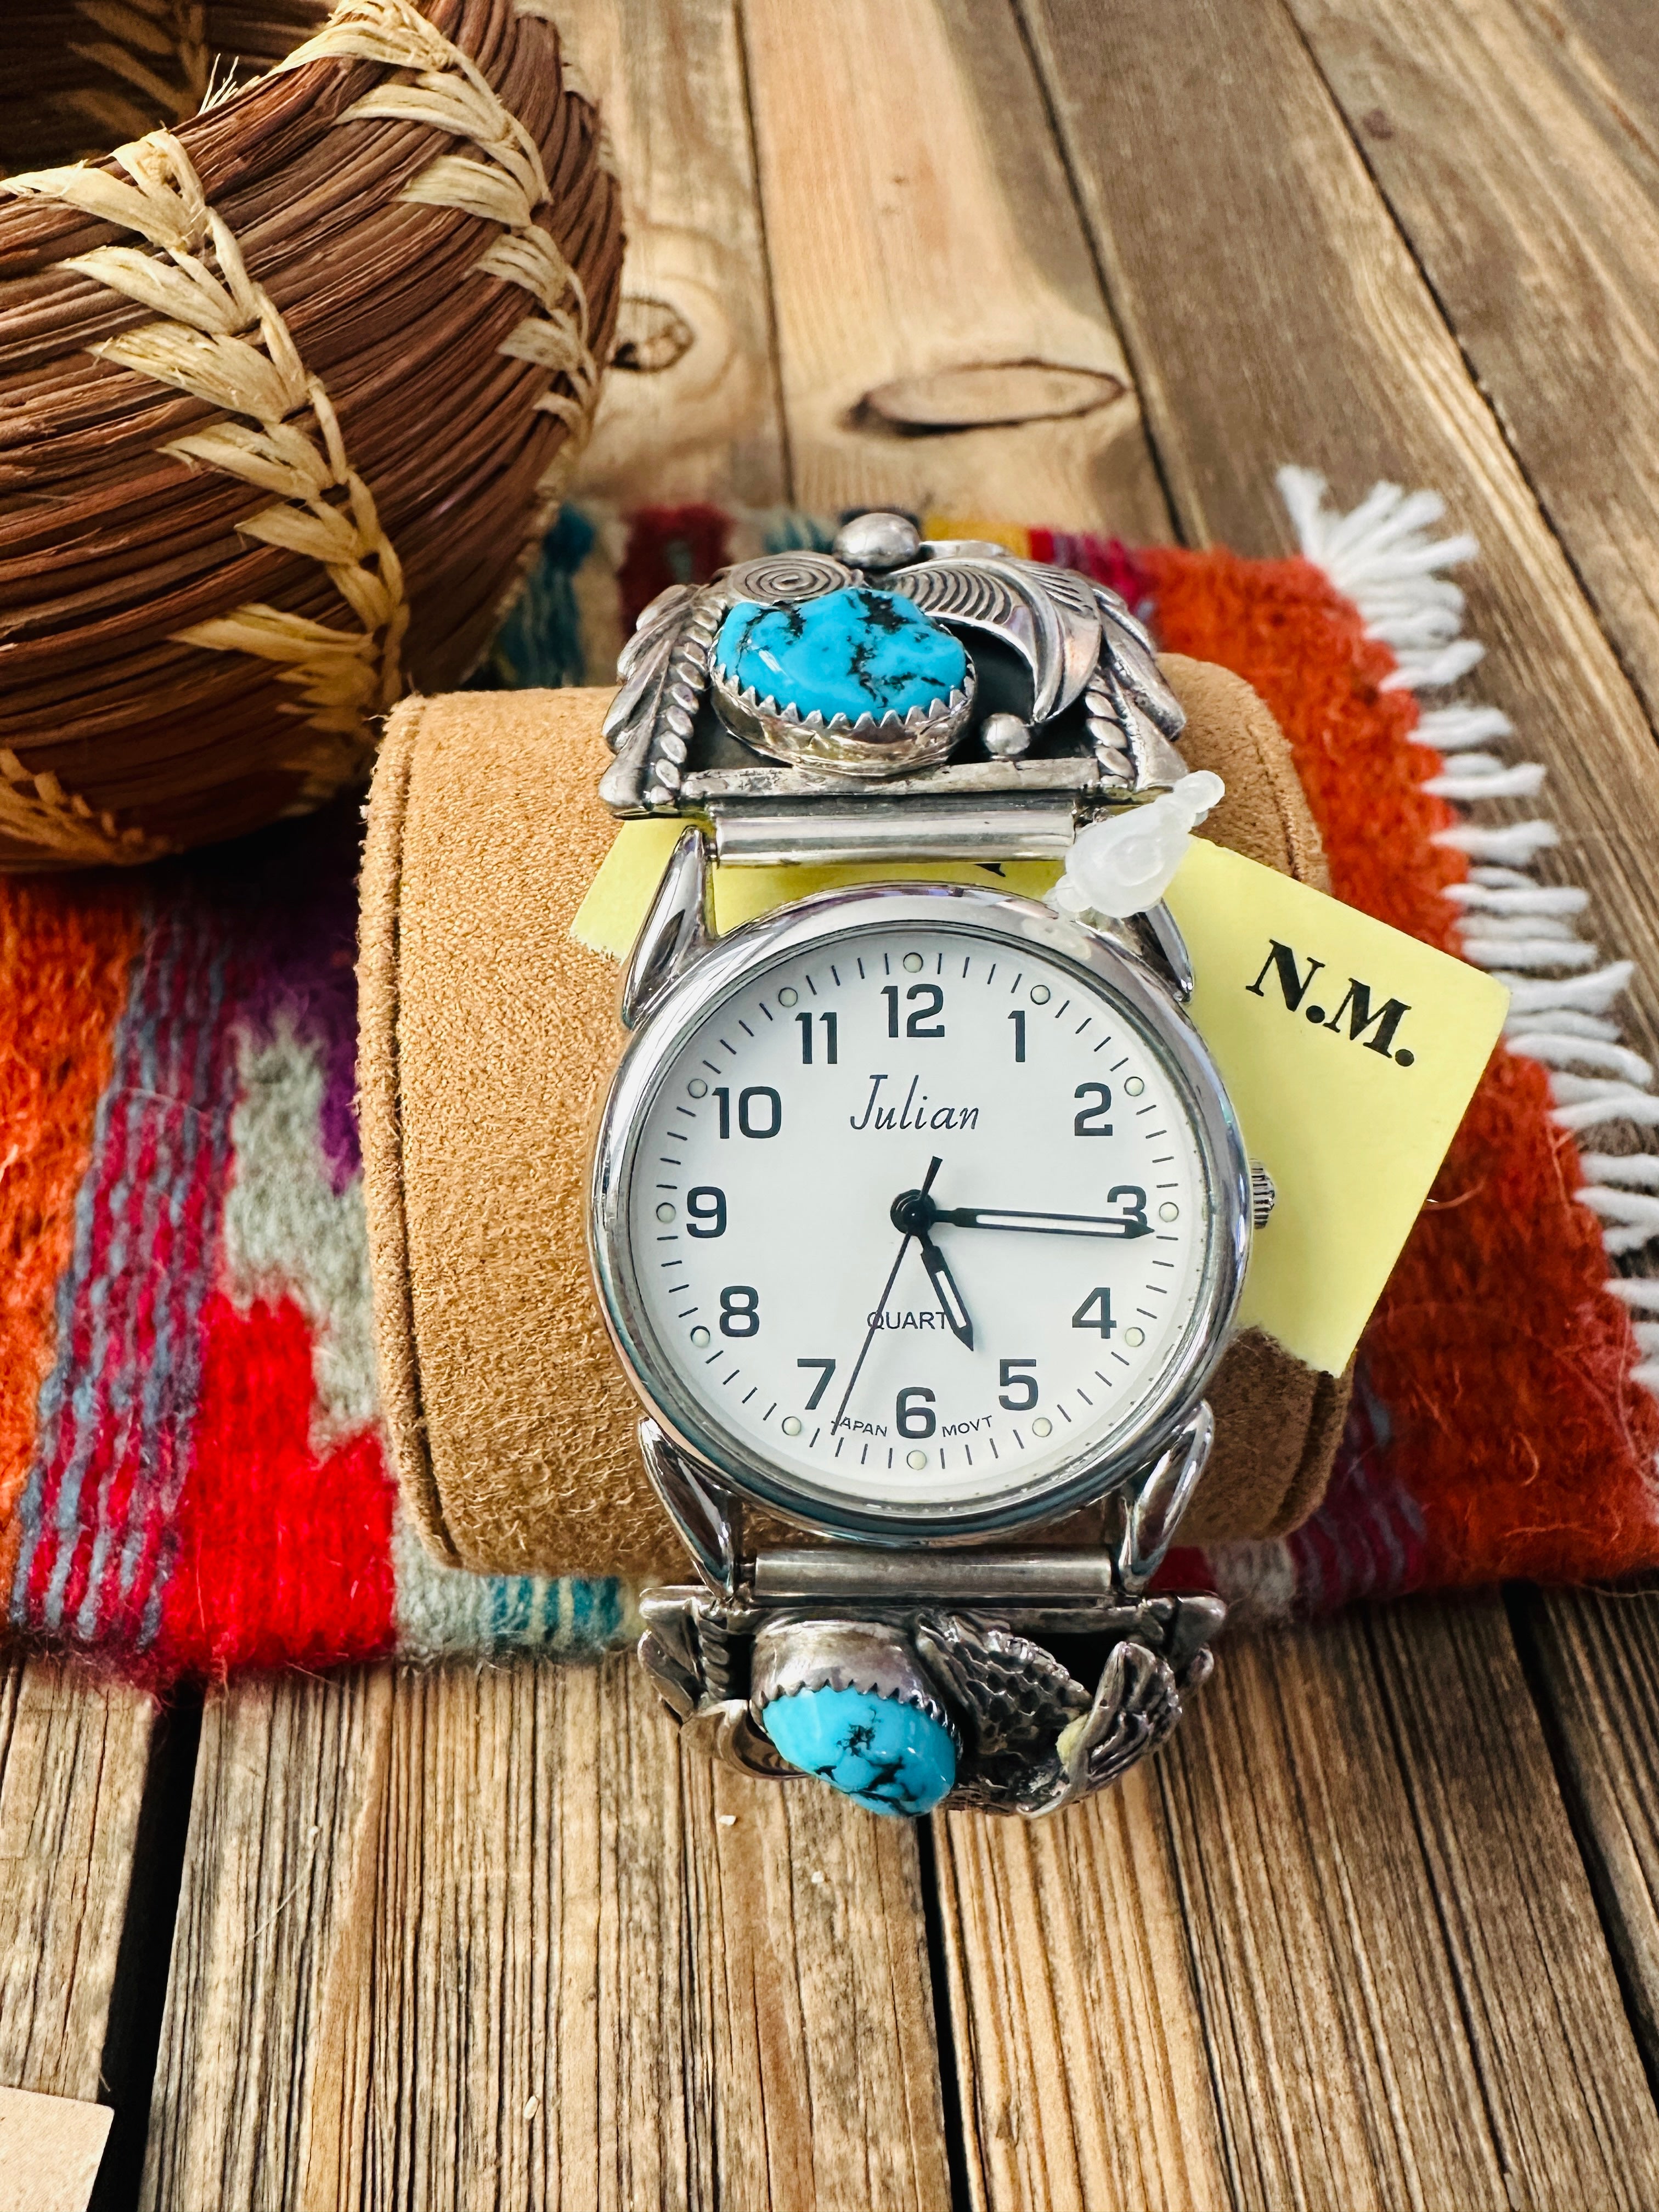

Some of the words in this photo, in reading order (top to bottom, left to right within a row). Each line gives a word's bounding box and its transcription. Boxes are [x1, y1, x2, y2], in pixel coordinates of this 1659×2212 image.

[880, 984, 945, 1038] 12
[1245, 939, 1415, 1067] N.M.
[794, 1012, 838, 1064] 11
[1007, 1010, 1025, 1063] 1
[712, 1086, 782, 1139] 10
[850, 1074, 979, 1130] Julian
[1074, 1082, 1113, 1137] 2
[686, 1186, 727, 1239] 9
[1107, 1185, 1148, 1229] 3
[719, 1285, 760, 1338] 8
[867, 1312, 952, 1330] QUART
[1072, 1287, 1117, 1339] 4
[797, 1358, 836, 1410] 7
[998, 1359, 1039, 1411] 5
[896, 1386, 936, 1439] 6
[941, 1415, 992, 1437] MOVT
